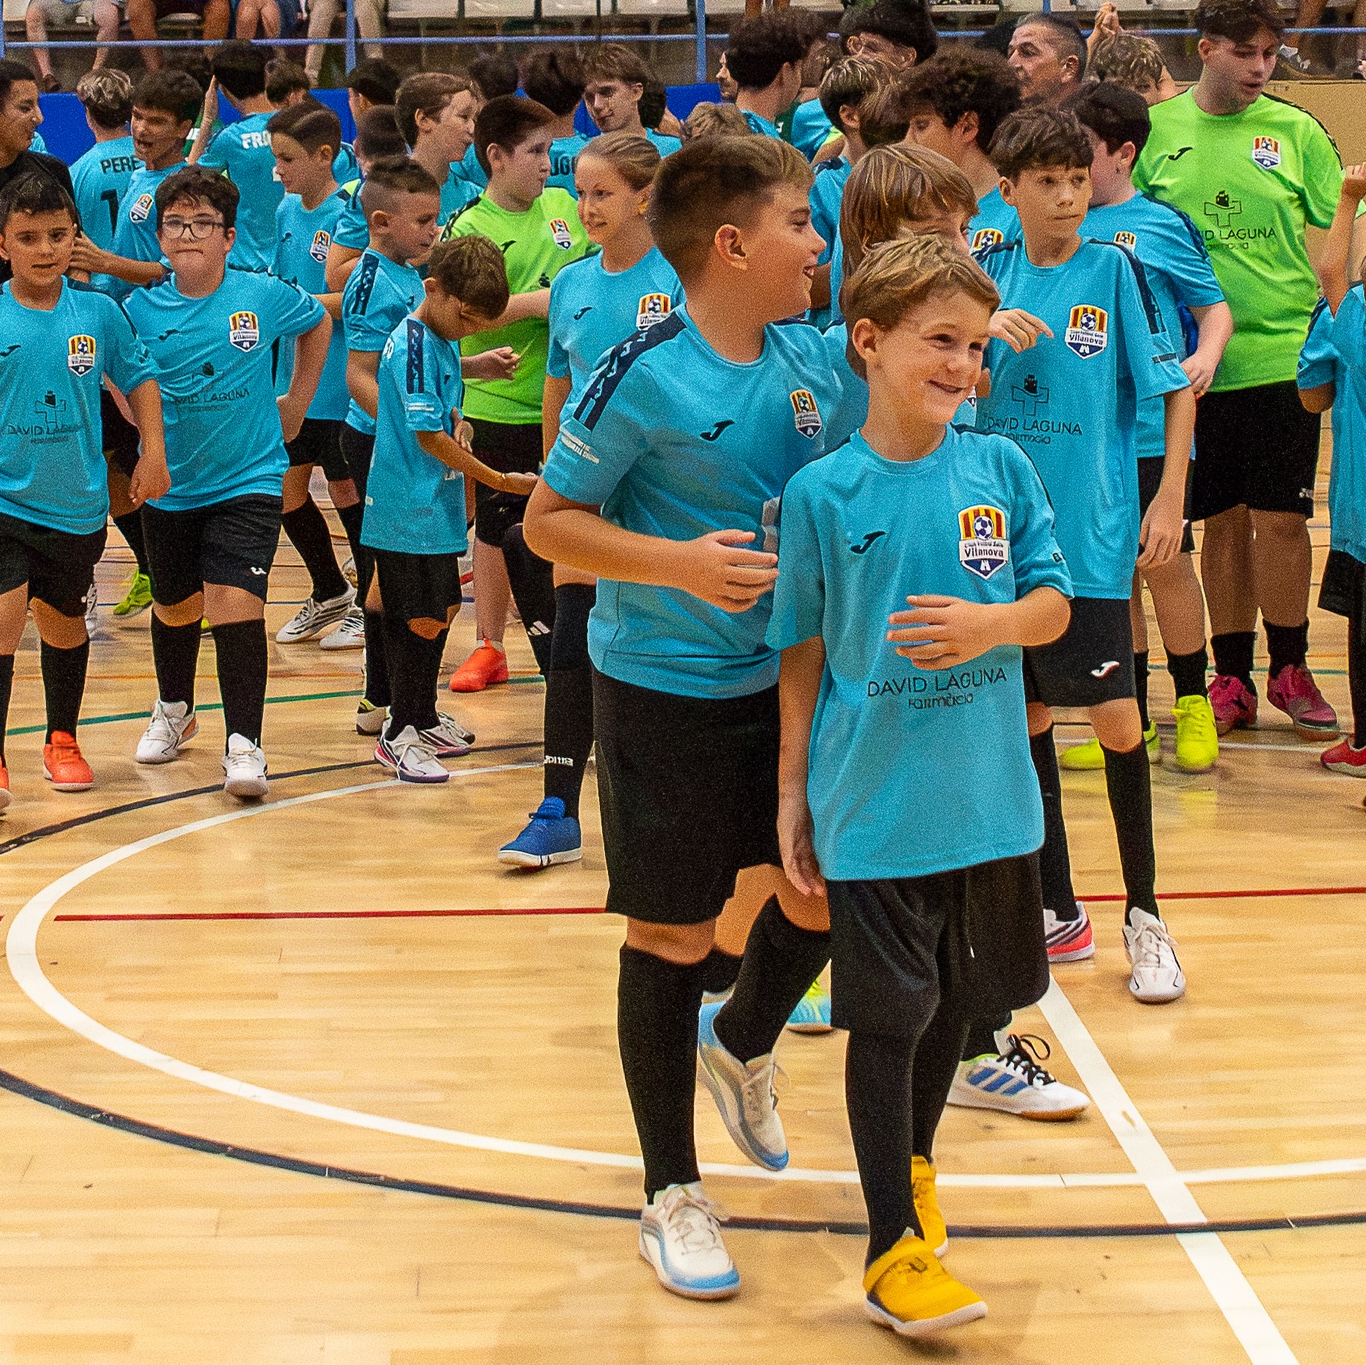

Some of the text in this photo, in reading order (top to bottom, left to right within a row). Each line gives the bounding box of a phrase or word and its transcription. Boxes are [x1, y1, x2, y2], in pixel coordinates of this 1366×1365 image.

[1220, 227, 1277, 240] LAGUNA
[1069, 334, 1104, 345] Vilanova
[6, 425, 43, 435] DAVID
[1024, 420, 1082, 435] LAGUNA
[964, 548, 1004, 558] Vilanova
[867, 667, 1007, 697] DAVID LAGUNA
